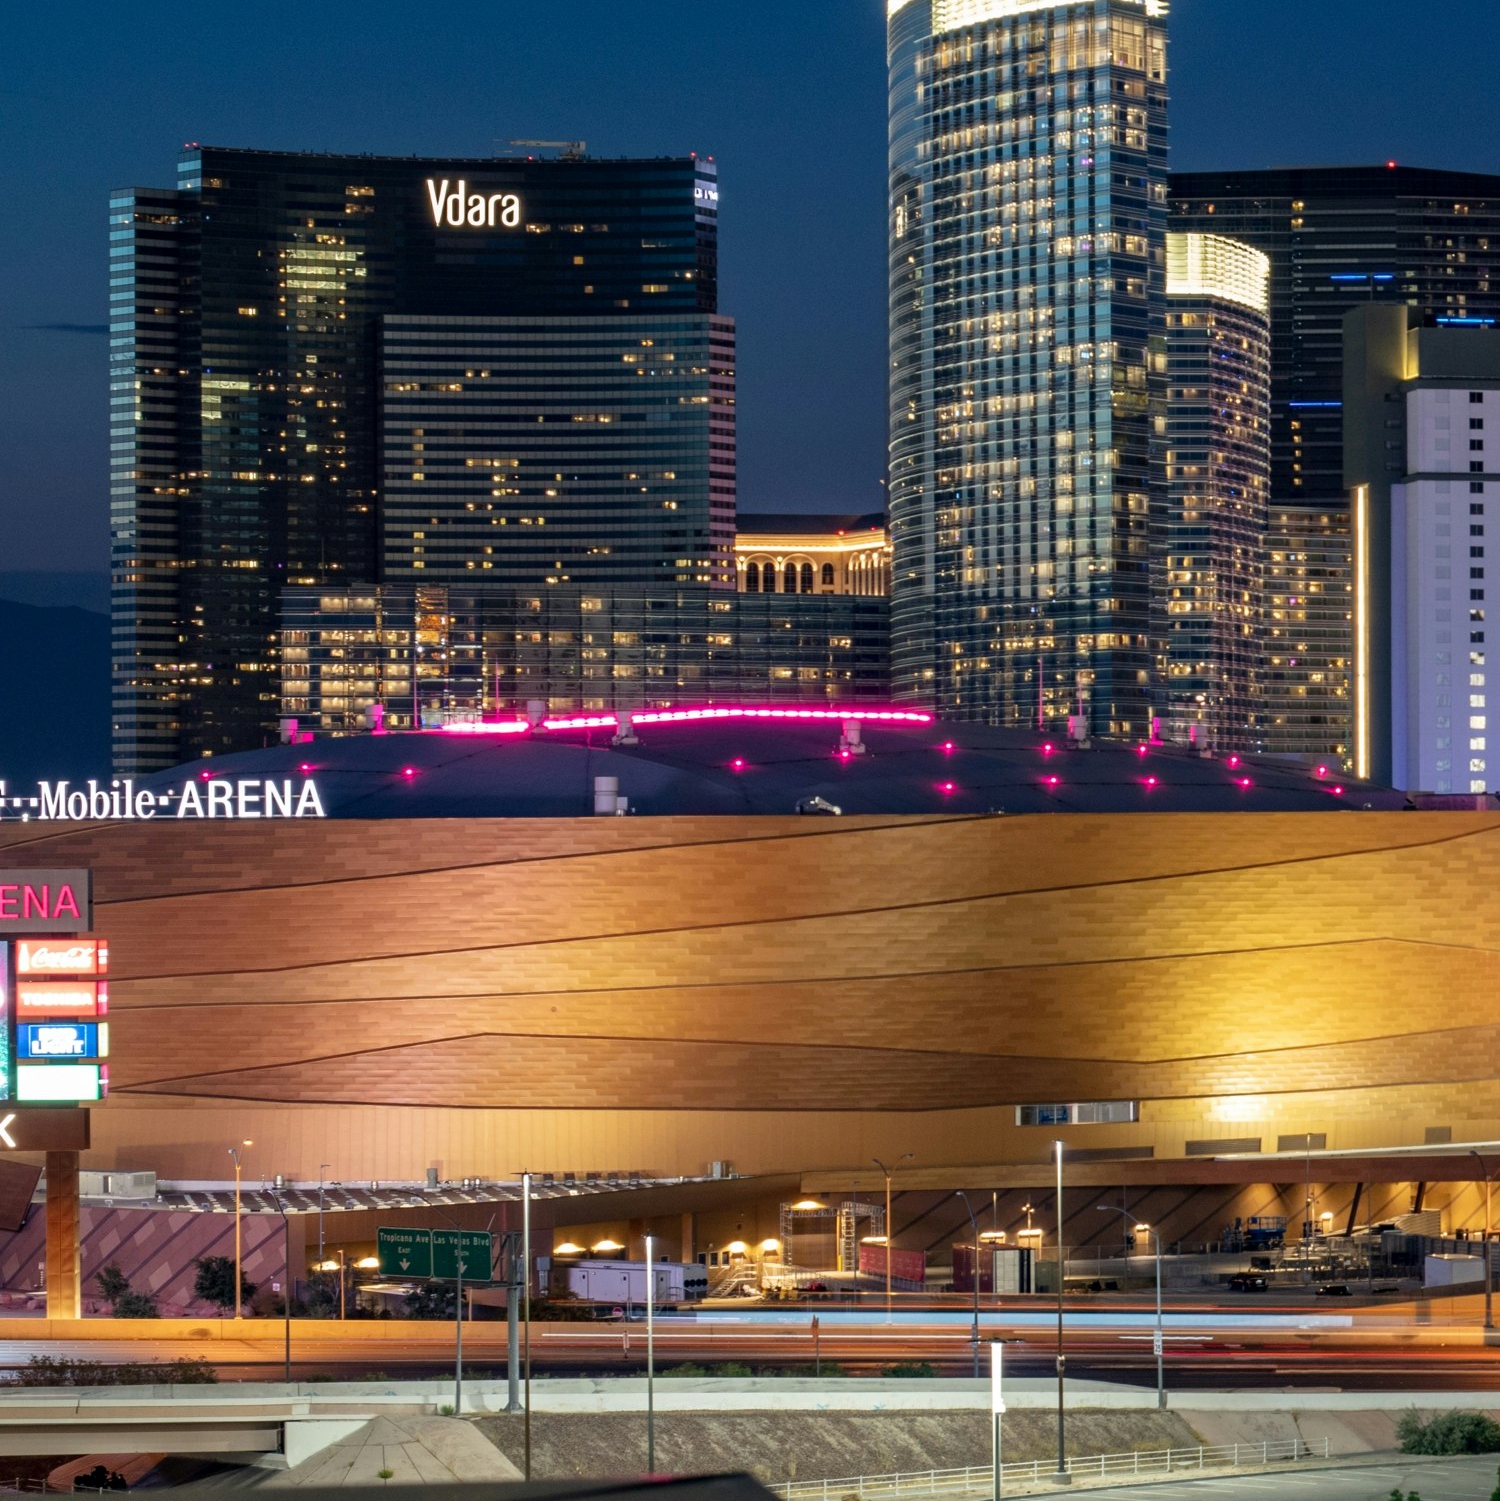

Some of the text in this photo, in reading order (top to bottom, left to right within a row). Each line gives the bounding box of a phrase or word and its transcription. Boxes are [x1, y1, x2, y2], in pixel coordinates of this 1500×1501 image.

[427, 179, 519, 227] Vdara
[177, 780, 325, 818] ARENA
[20, 993, 93, 1006] TOSHIBA
[38, 1028, 77, 1042] BUD
[31, 1040, 84, 1055] LIGHT
[380, 1233, 429, 1243] Tropicana Ave
[433, 1235, 490, 1247] Las Veas Blvd
[454, 1249, 470, 1257] SUTH
